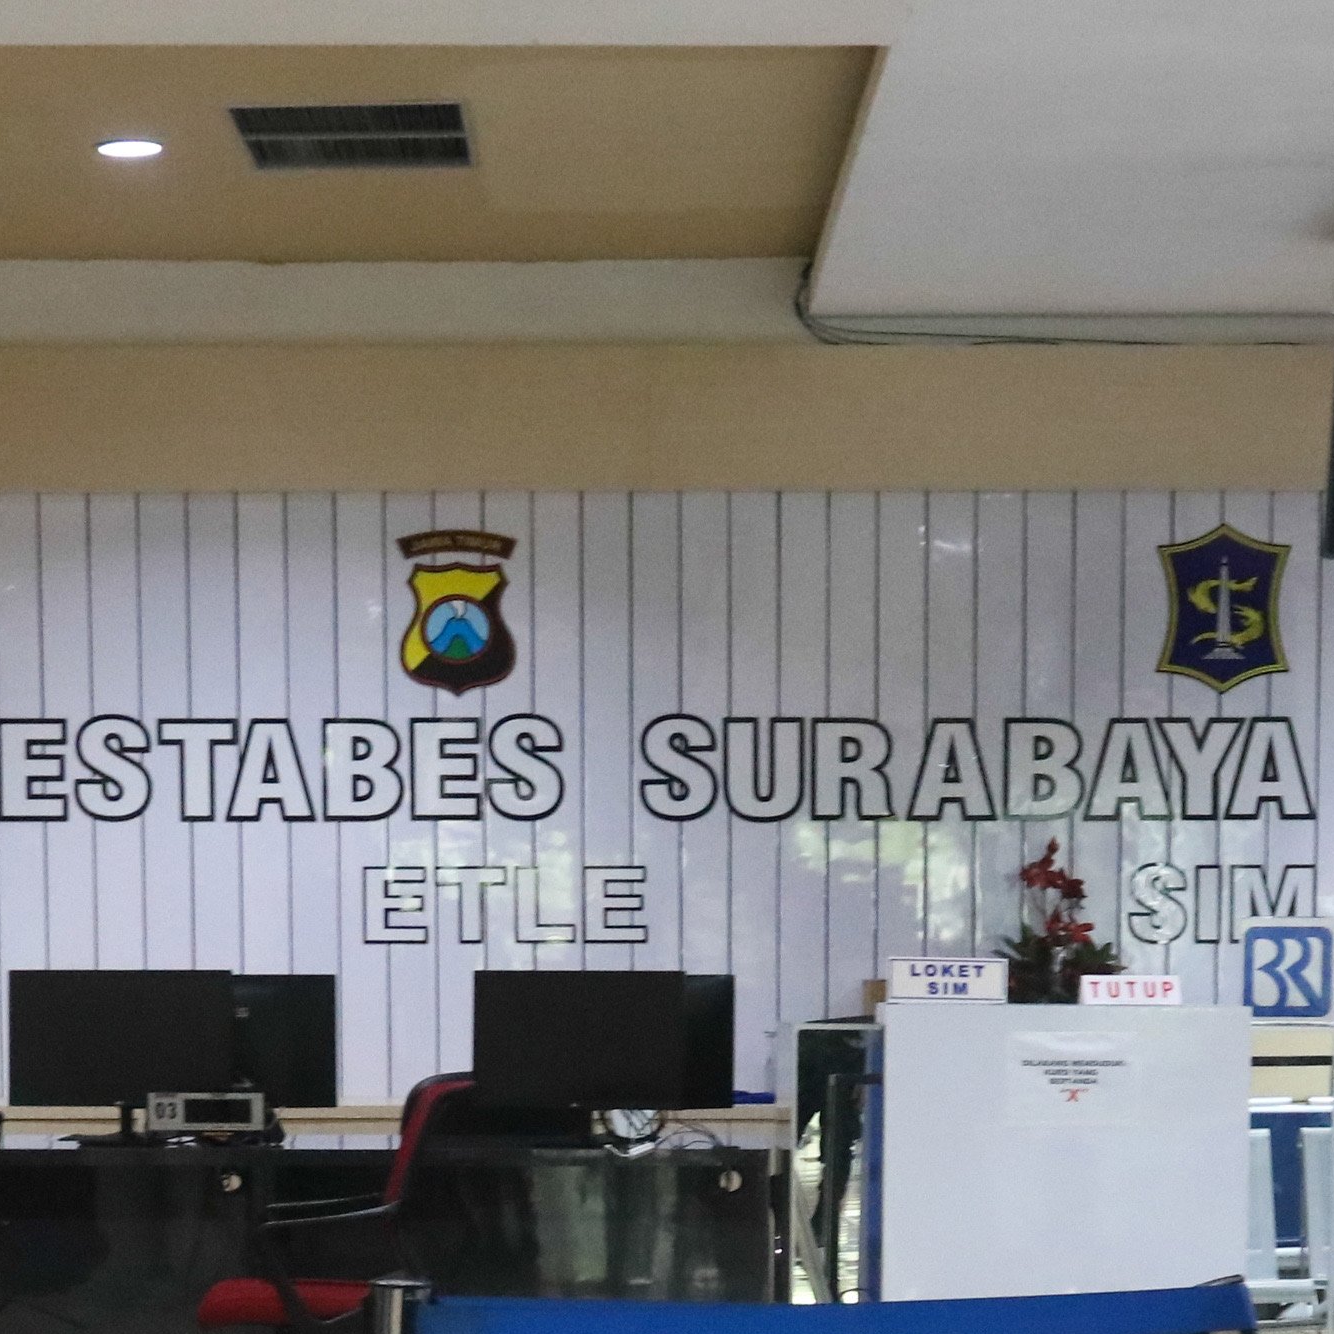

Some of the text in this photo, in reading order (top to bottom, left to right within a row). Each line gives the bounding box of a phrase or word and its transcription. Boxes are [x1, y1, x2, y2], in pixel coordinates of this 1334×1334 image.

[638, 712, 1317, 822] SURABAYA
[362, 863, 649, 945] ETLE
[1127, 861, 1317, 945] SIM
[909, 963, 986, 978] LOKET
[926, 981, 969, 996] SIM
[1089, 980, 1174, 999] TUTUP
[154, 1101, 177, 1120] 03
